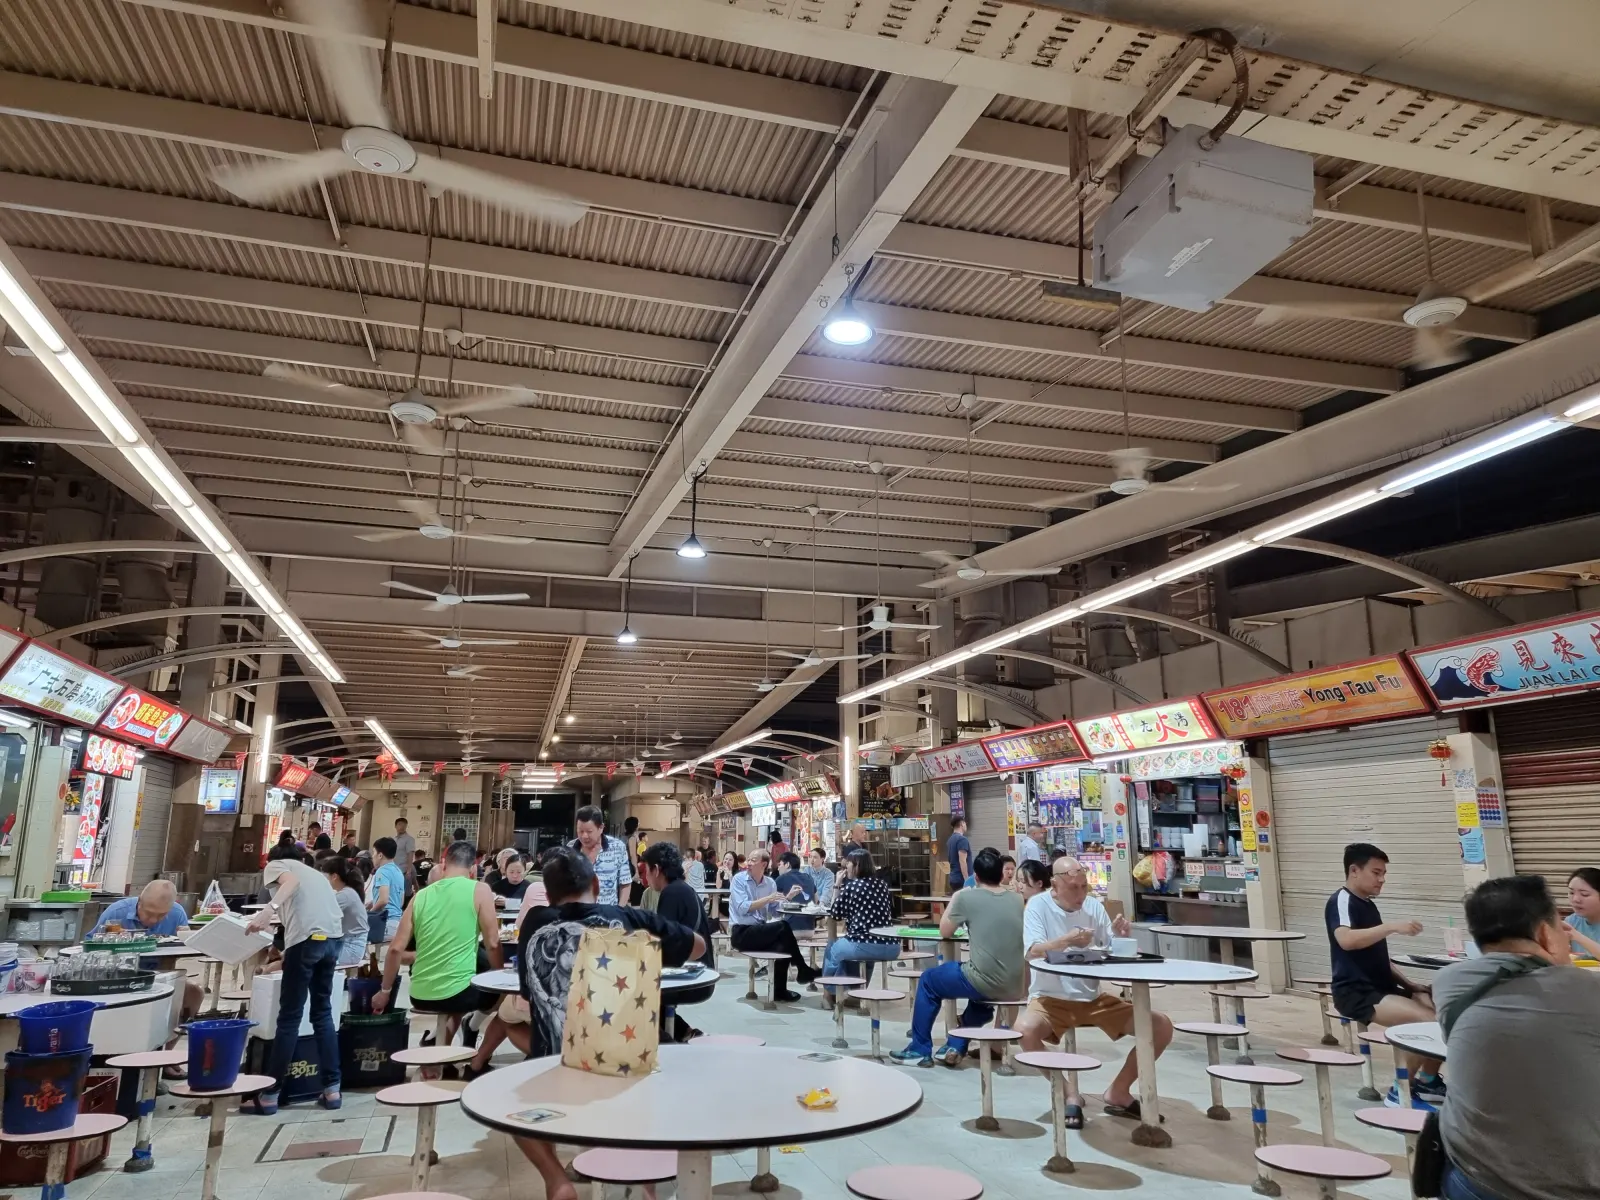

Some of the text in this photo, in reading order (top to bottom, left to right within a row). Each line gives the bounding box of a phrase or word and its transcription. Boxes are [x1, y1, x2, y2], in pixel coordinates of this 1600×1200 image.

[1519, 673, 1556, 689] JIAN
[1557, 667, 1588, 684] LAI
[1303, 674, 1402, 704] Yong Tau Fu
[23, 1093, 66, 1113] Tiger
[18, 1145, 49, 1159] Carlsber
